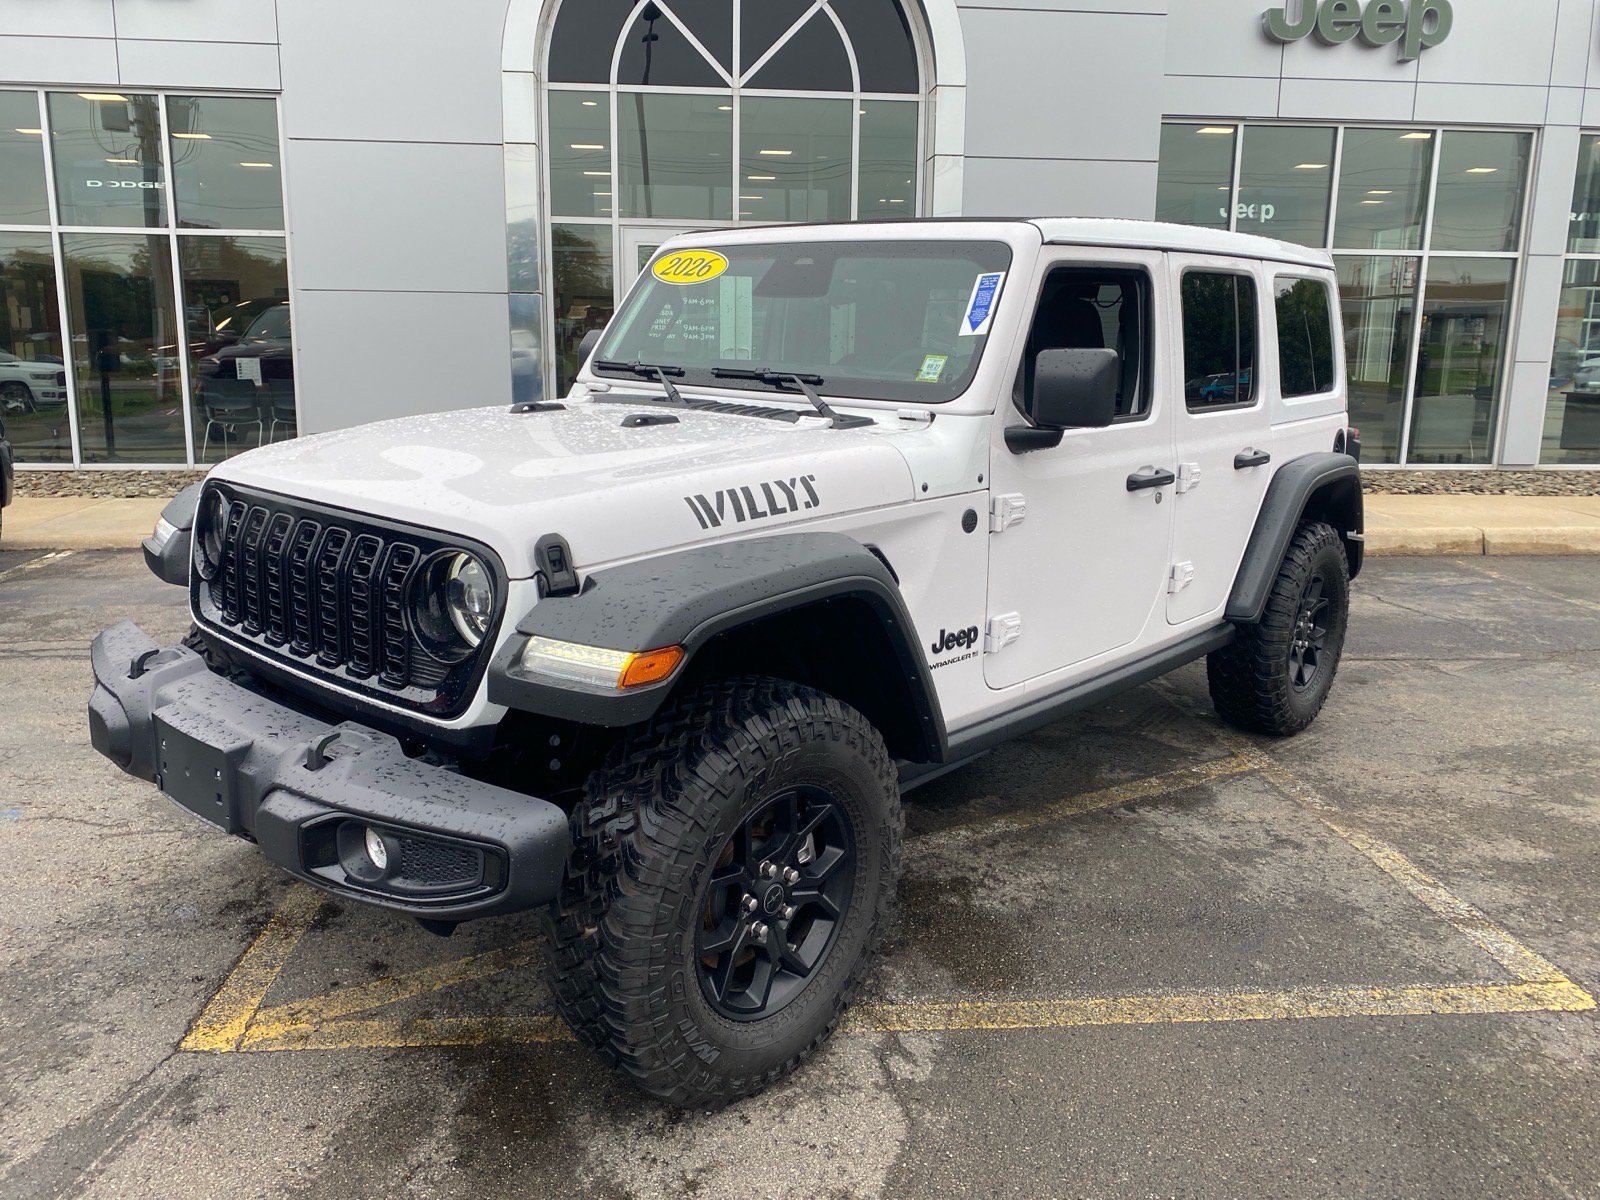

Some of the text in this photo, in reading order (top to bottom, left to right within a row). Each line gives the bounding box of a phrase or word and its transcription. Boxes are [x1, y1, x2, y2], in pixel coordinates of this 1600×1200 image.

[1262, 0, 1453, 62] Jeep
[659, 257, 720, 277] 2026
[683, 474, 820, 529] WILLYS
[931, 625, 979, 654] Jeep
[929, 653, 972, 671] WRANGLER
